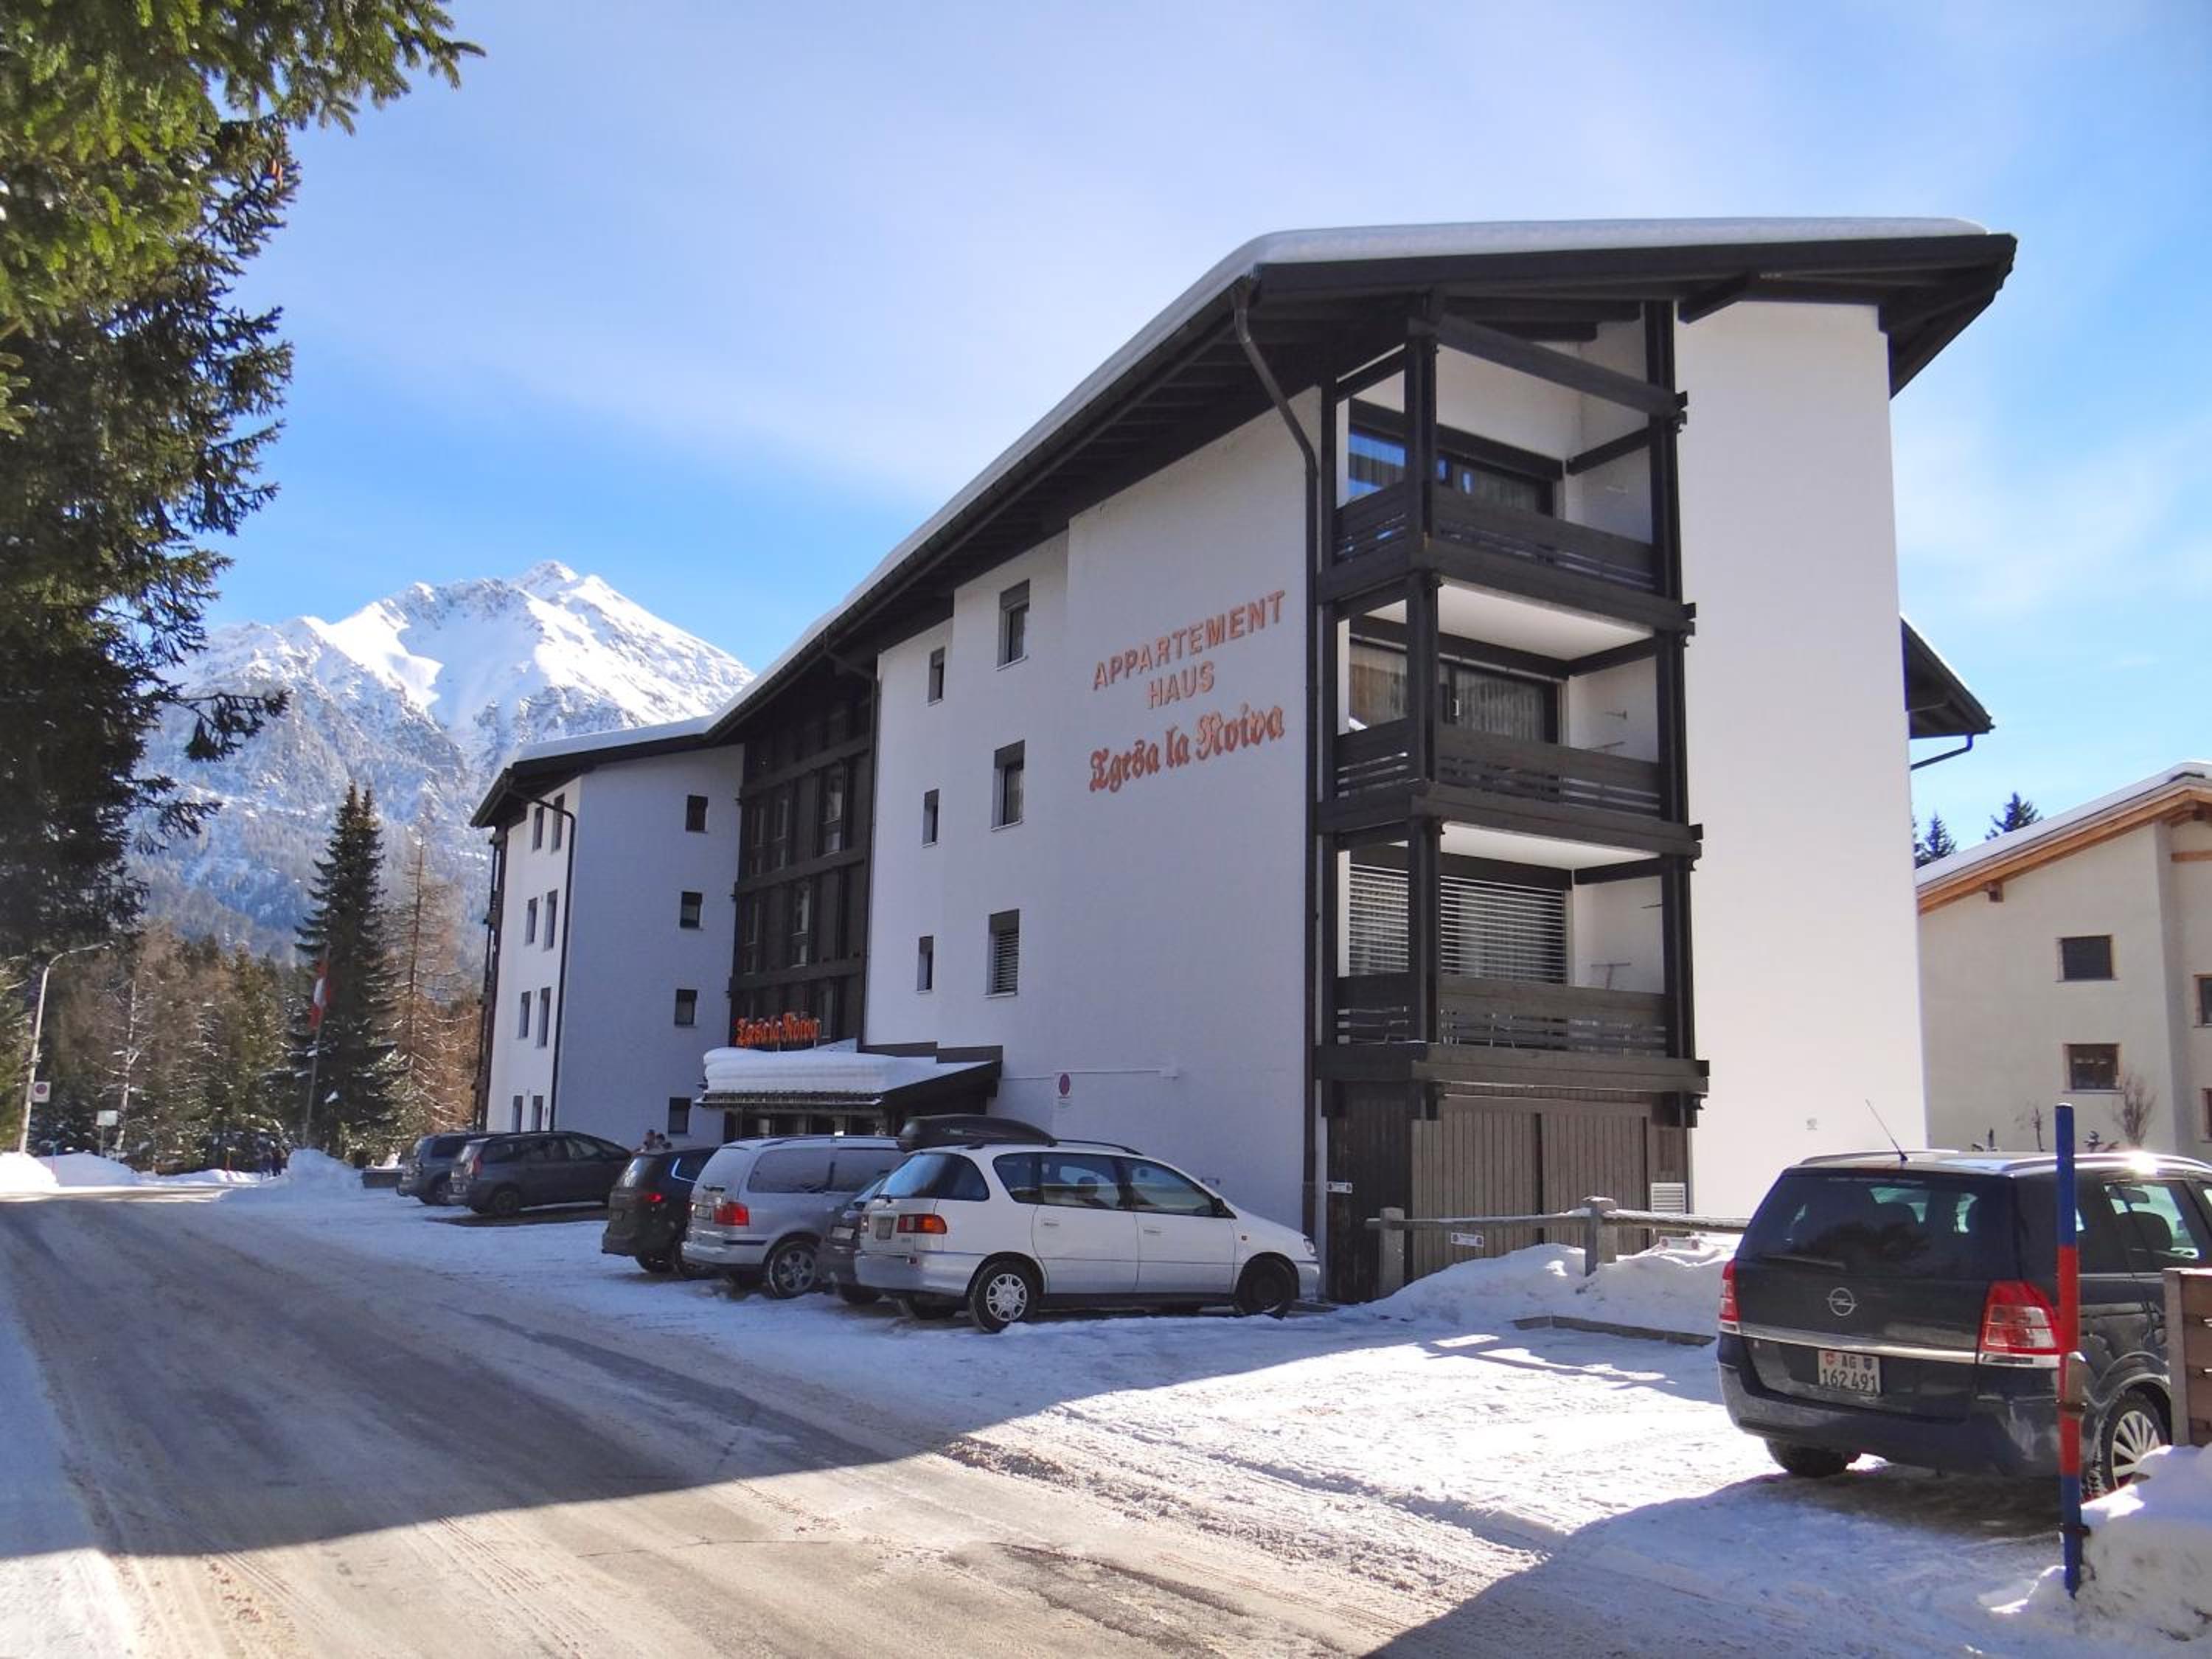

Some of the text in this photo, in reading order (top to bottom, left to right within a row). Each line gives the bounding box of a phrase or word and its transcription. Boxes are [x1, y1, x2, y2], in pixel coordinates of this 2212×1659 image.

[1093, 589, 1285, 692] APPARTEMENT
[1147, 660, 1215, 709] HAUS
[1166, 726, 1191, 768] la
[1841, 1354, 1857, 1369] AG
